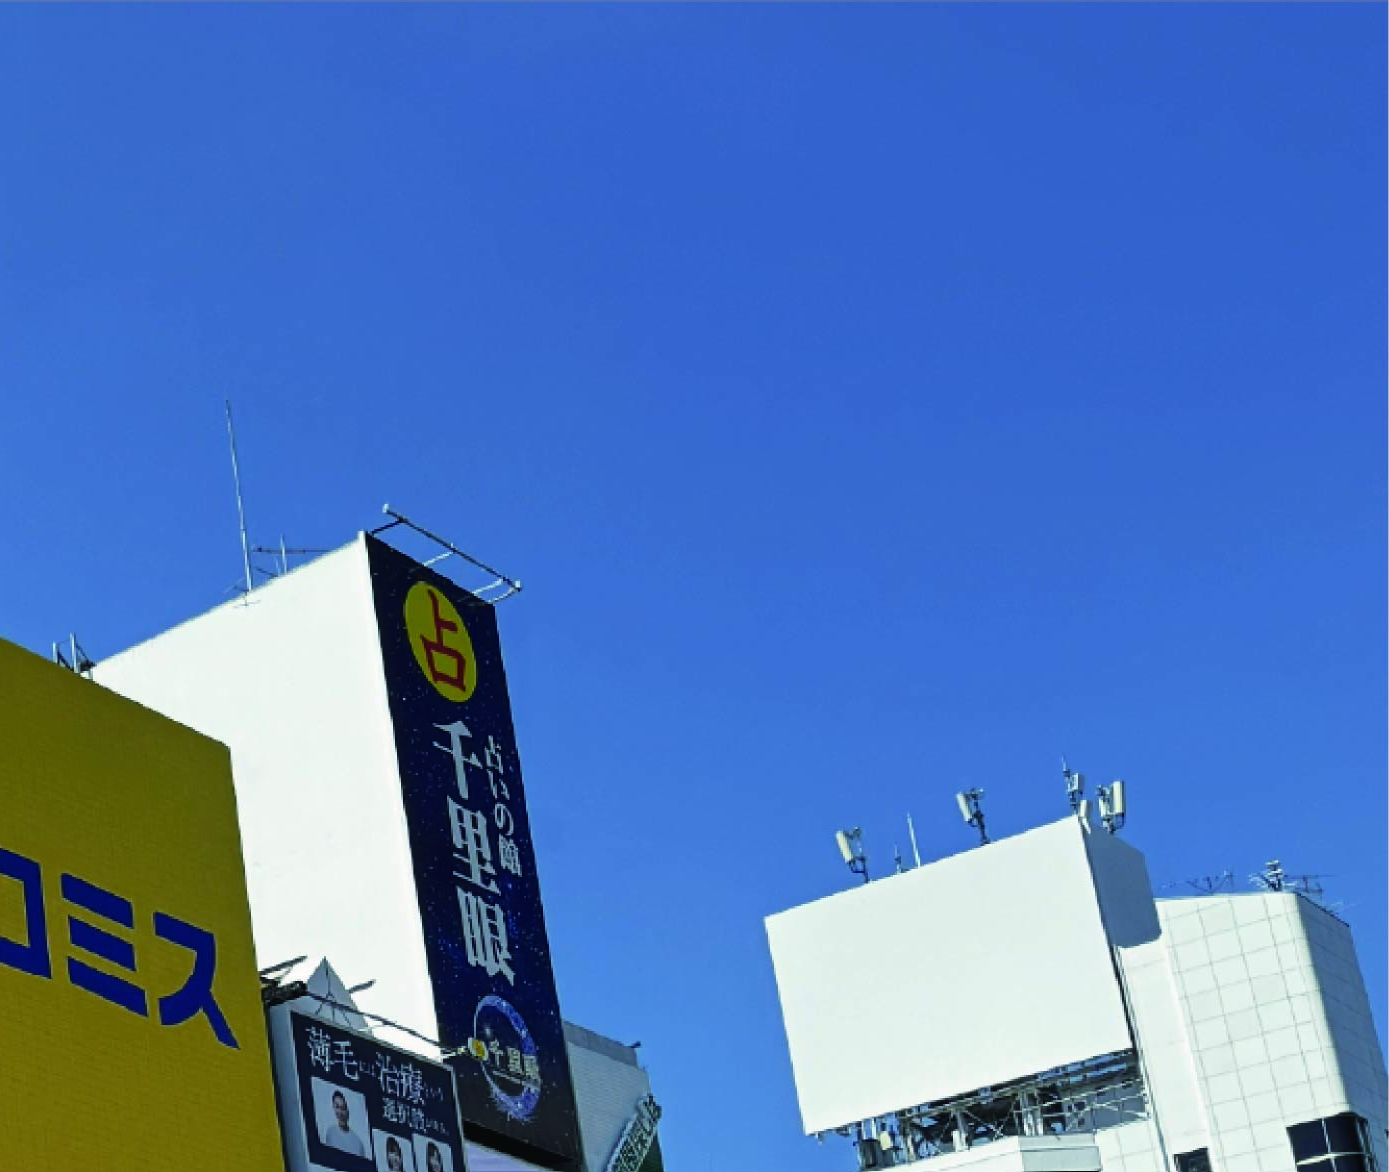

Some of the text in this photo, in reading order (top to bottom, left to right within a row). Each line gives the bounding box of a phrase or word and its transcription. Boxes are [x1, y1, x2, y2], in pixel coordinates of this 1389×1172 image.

[421, 588, 466, 692] 占
[432, 720, 516, 986] 千里眼
[484, 734, 522, 876] 占いの館
